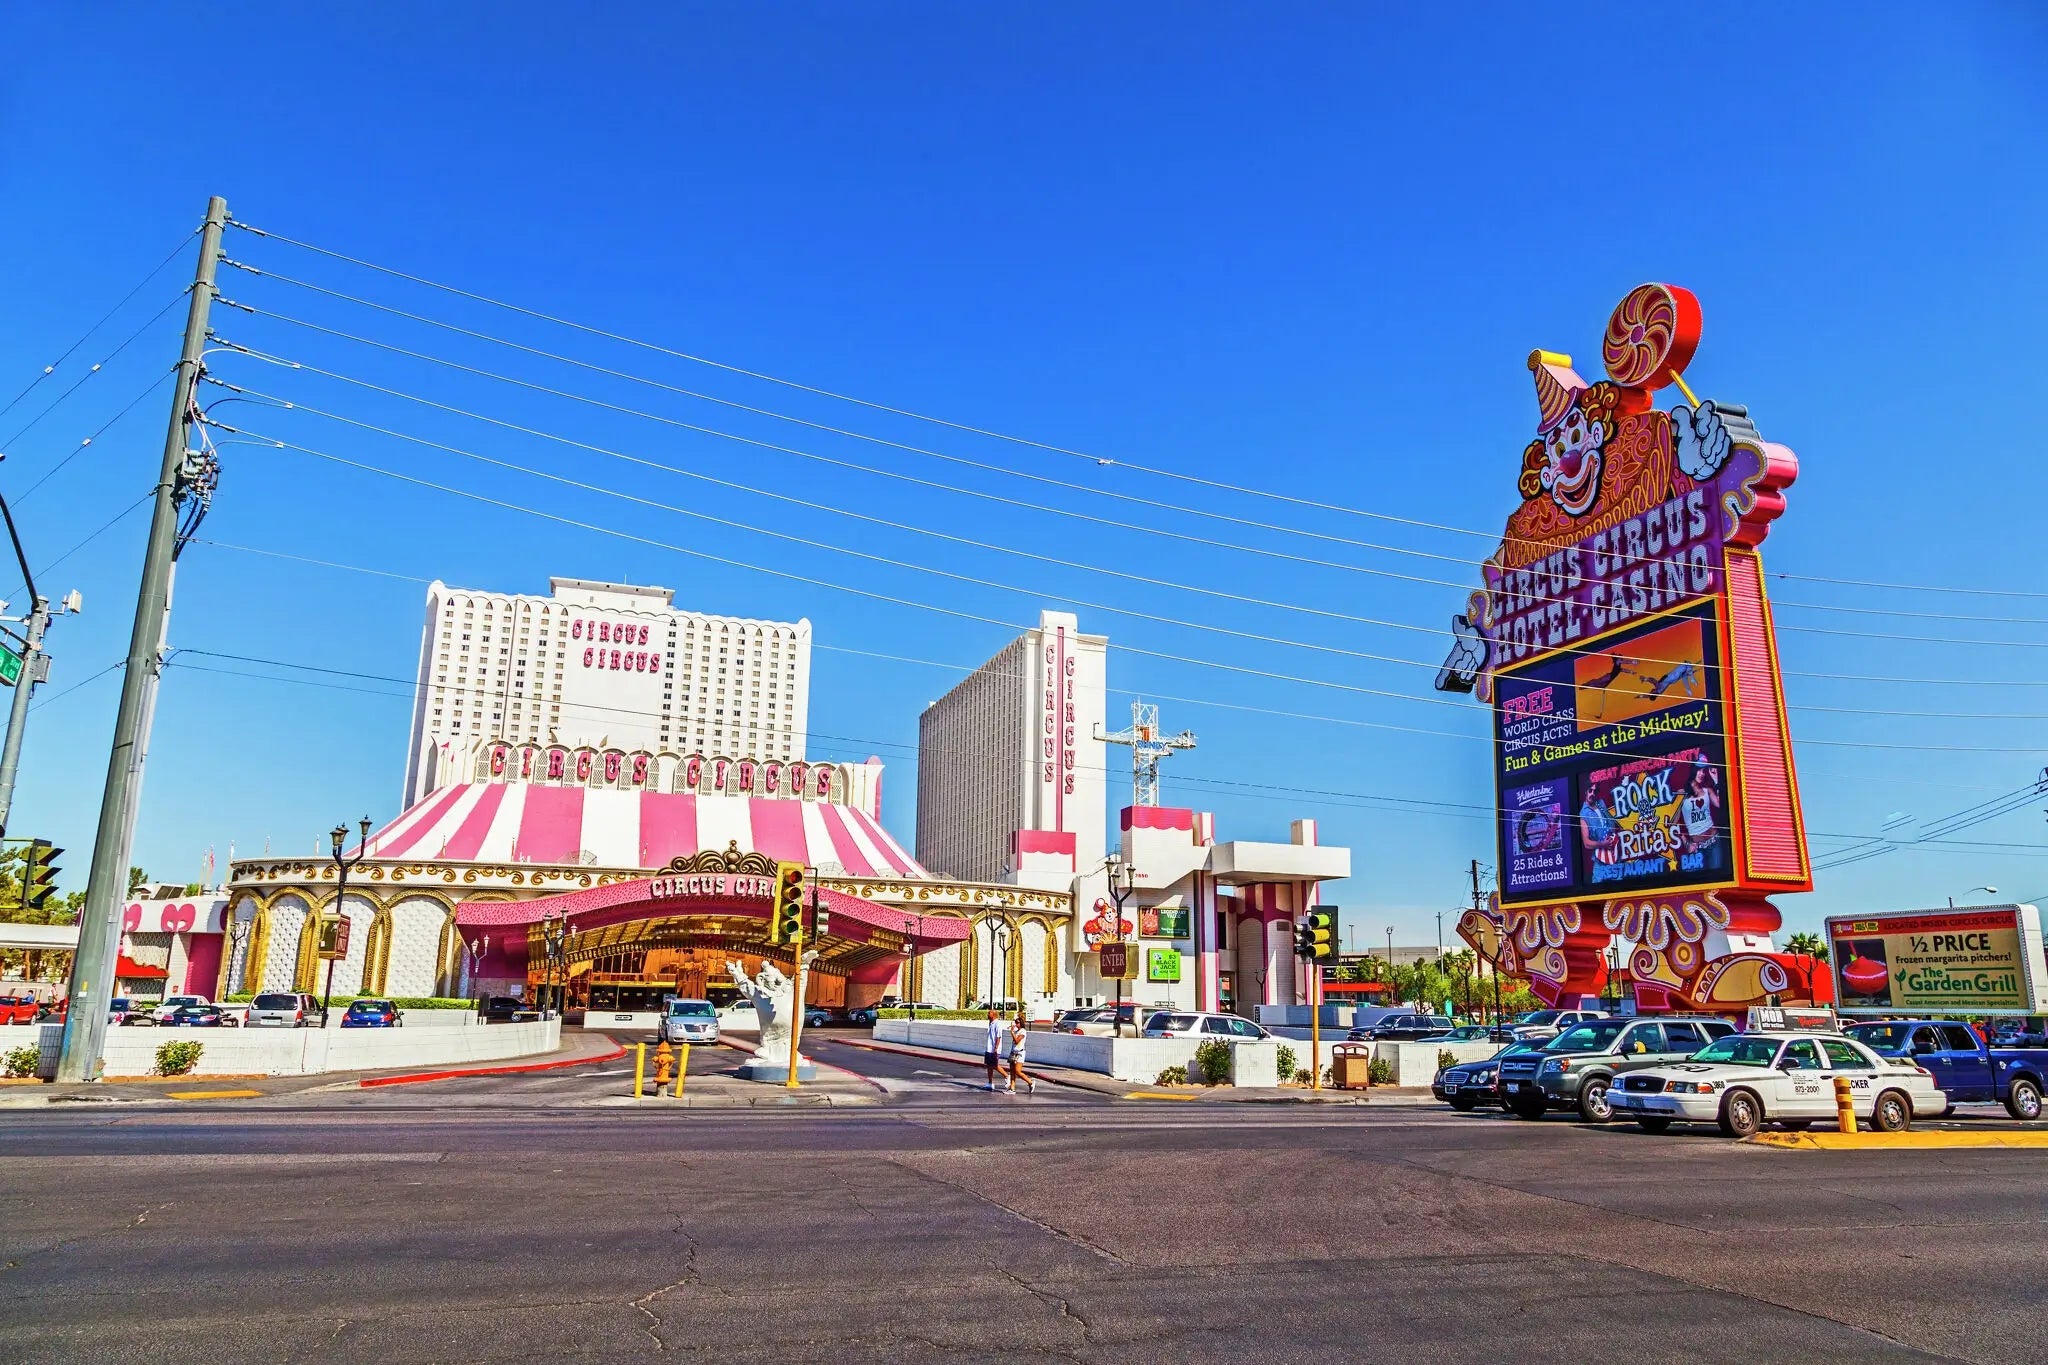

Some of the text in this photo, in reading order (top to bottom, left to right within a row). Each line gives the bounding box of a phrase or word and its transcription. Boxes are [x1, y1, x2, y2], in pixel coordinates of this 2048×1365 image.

[1492, 490, 1707, 619] CIRCUS CIRCUS
[1493, 545, 1709, 664] HOTEL CASINO
[573, 619, 650, 645] CIRCUS
[584, 648, 660, 673] CIRCUS
[1045, 644, 1055, 783] CIRCUS
[1503, 687, 1553, 724] FREE
[1065, 656, 1075, 794] CIRCUS
[1504, 708, 1575, 737] WORLD CLASS
[1505, 704, 1709, 771] Fun & Games at the Midway!
[1505, 724, 1572, 752] CIRCUS ACTS!
[492, 746, 832, 794] CIRCUS CIRCUS
[1668, 748, 1700, 767] PARTY
[1611, 767, 1675, 818] ROCK
[1617, 815, 1682, 860] Rita's
[1514, 853, 1563, 871] 25 Rides &
[1600, 852, 1704, 880] RESTAURANT BAR
[651, 875, 726, 897] CIRCUS
[1511, 867, 1568, 885] Attractions!
[1884, 921, 1920, 930] LOCATED
[1921, 920, 1946, 928] INSIDE
[1933, 933, 1991, 951] PRICE
[1102, 953, 1125, 966] ENTER
[1896, 952, 2012, 965] Frozen margarita pitchers!
[1908, 973, 2018, 992] Garden Grill
[1921, 967, 1942, 978] The
